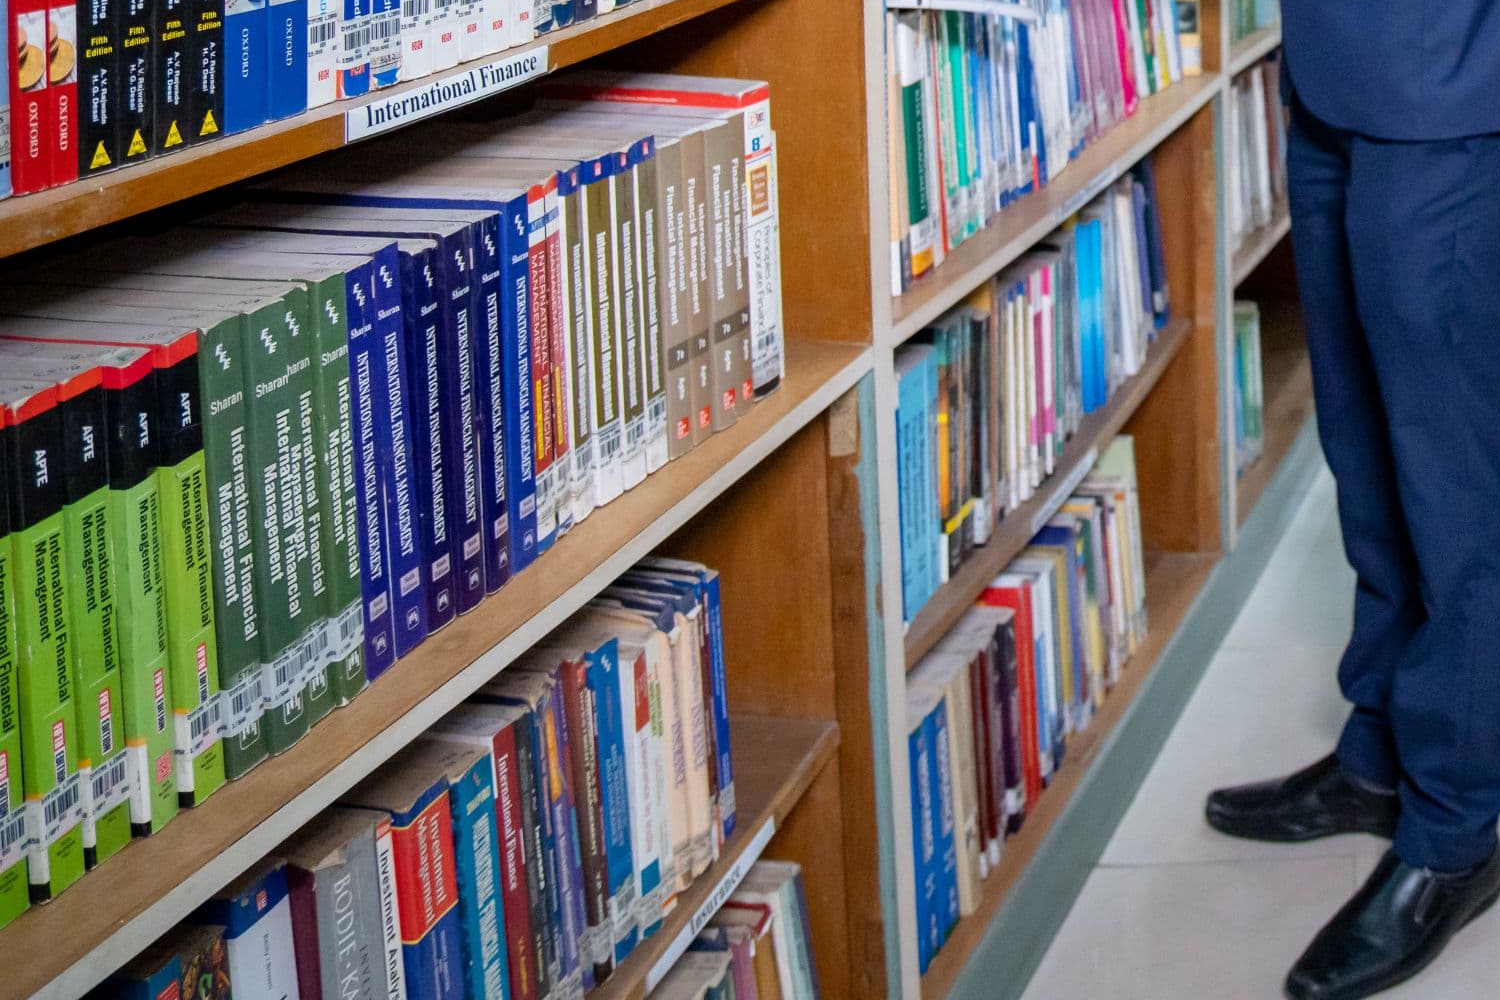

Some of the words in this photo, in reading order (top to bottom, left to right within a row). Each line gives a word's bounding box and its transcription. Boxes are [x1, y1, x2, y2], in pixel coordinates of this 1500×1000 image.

[86, 46, 112, 58] Edition
[91, 36, 108, 46] Fifth
[367, 80, 476, 127] International
[479, 56, 537, 88] Finance
[29, 102, 38, 158] OXFORD
[210, 391, 243, 416] Sharan
[358, 351, 373, 439] INTERNATIONAL
[35, 450, 48, 488] APTE
[230, 426, 252, 550] International
[362, 442, 377, 504] FINANCIAL
[219, 482, 239, 606] Management
[366, 504, 382, 580] MANAGEMENT
[35, 540, 51, 642] Management
[50, 532, 66, 632] International
[240, 553, 258, 641] Financial
[56, 635, 71, 703] Financial
[417, 817, 435, 925] Management
[430, 812, 446, 904] Investment
[380, 850, 397, 944] Investment
[691, 869, 741, 935] Insurance
